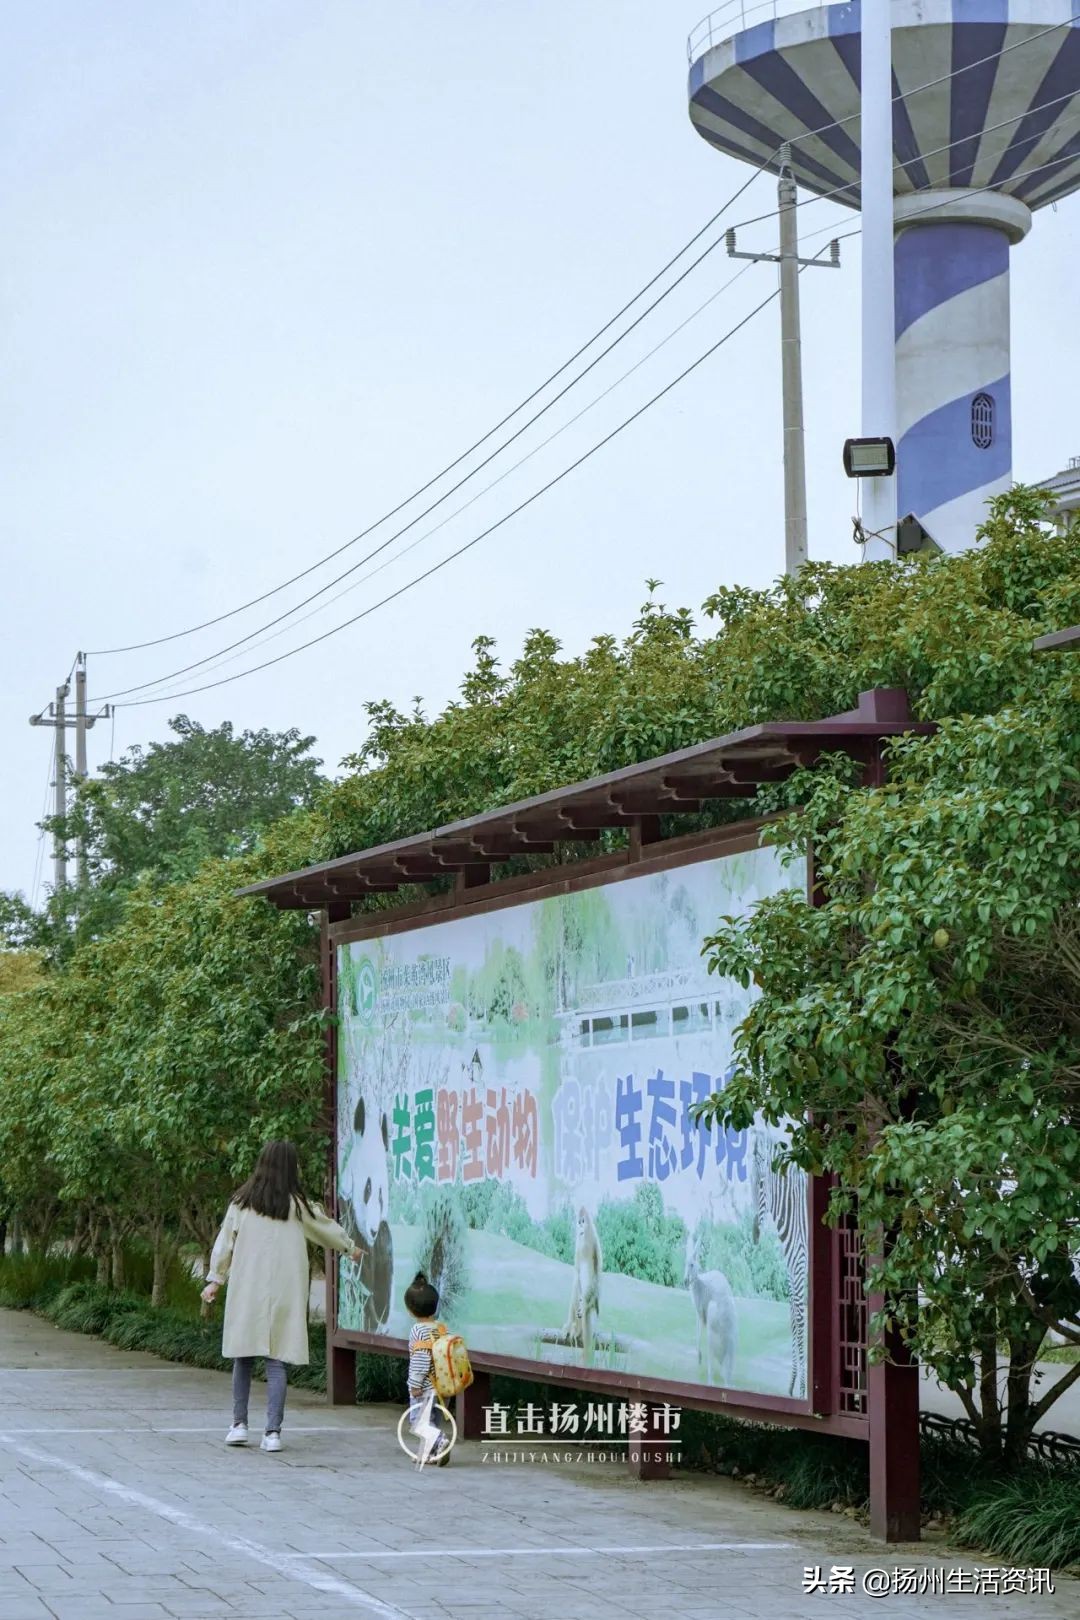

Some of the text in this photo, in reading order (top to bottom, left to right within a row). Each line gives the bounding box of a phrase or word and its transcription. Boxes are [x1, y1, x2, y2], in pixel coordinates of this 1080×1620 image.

[391, 1086, 538, 1181] 关爱野生动物
